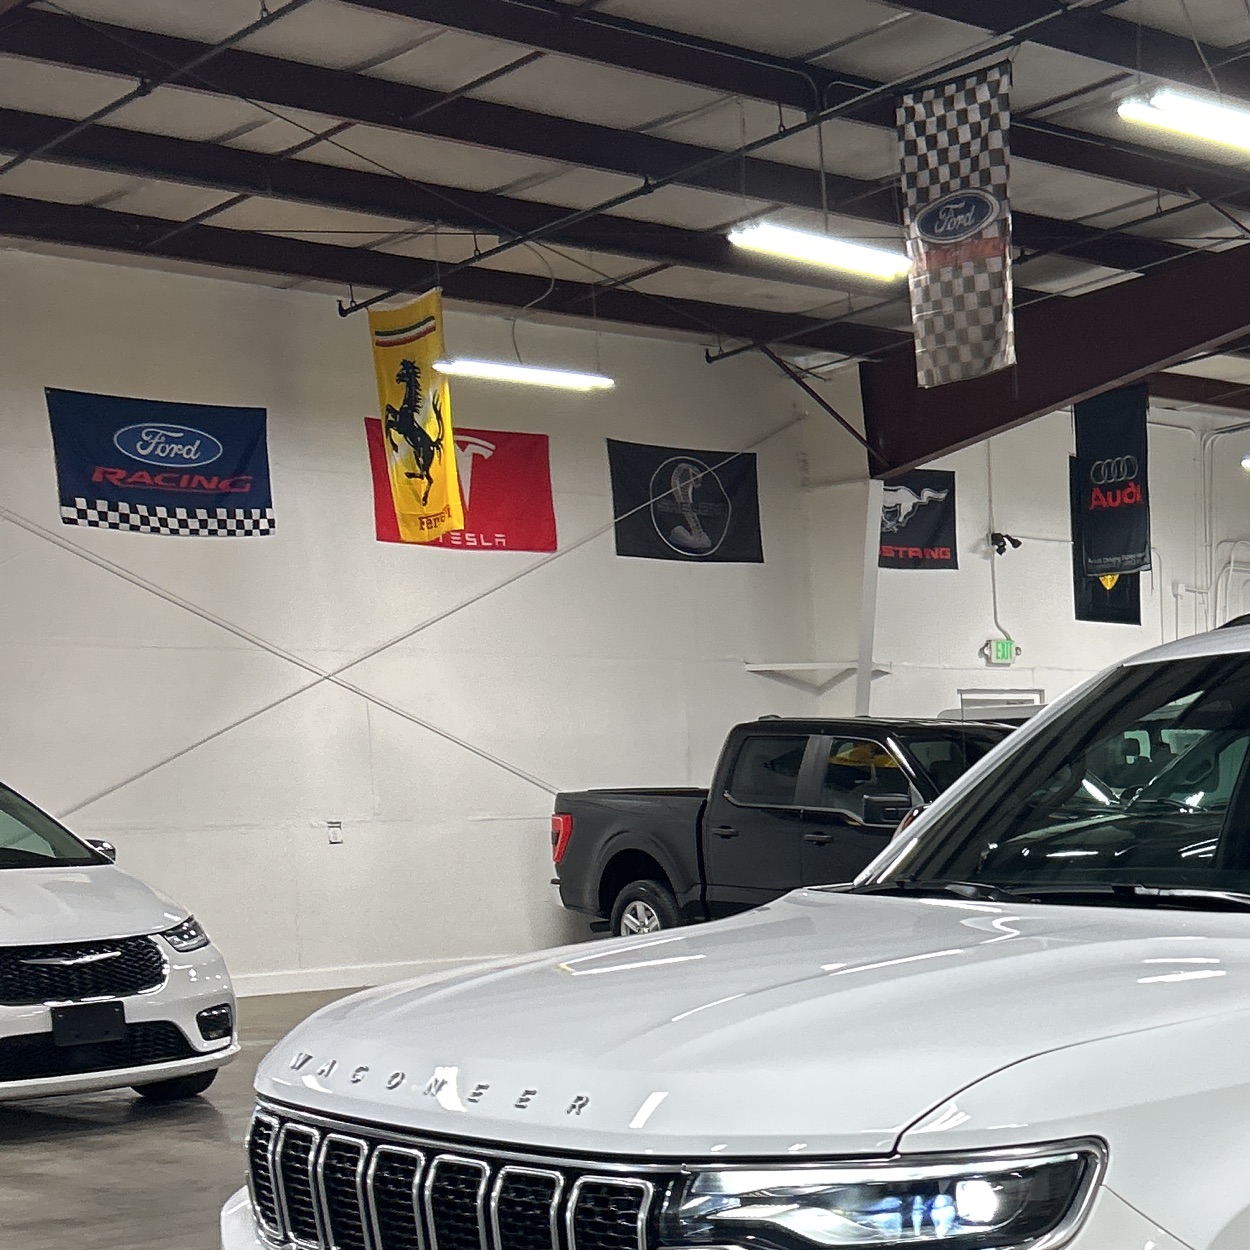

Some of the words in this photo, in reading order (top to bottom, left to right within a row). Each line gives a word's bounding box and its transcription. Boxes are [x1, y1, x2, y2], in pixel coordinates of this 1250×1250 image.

[935, 200, 976, 233] Ford
[136, 428, 200, 460] Ford
[92, 466, 253, 493] RACING
[1088, 481, 1143, 510] Audi
[880, 545, 951, 560] STANG
[996, 641, 1013, 660] EXIT
[289, 1052, 590, 1116] WAGONEER
